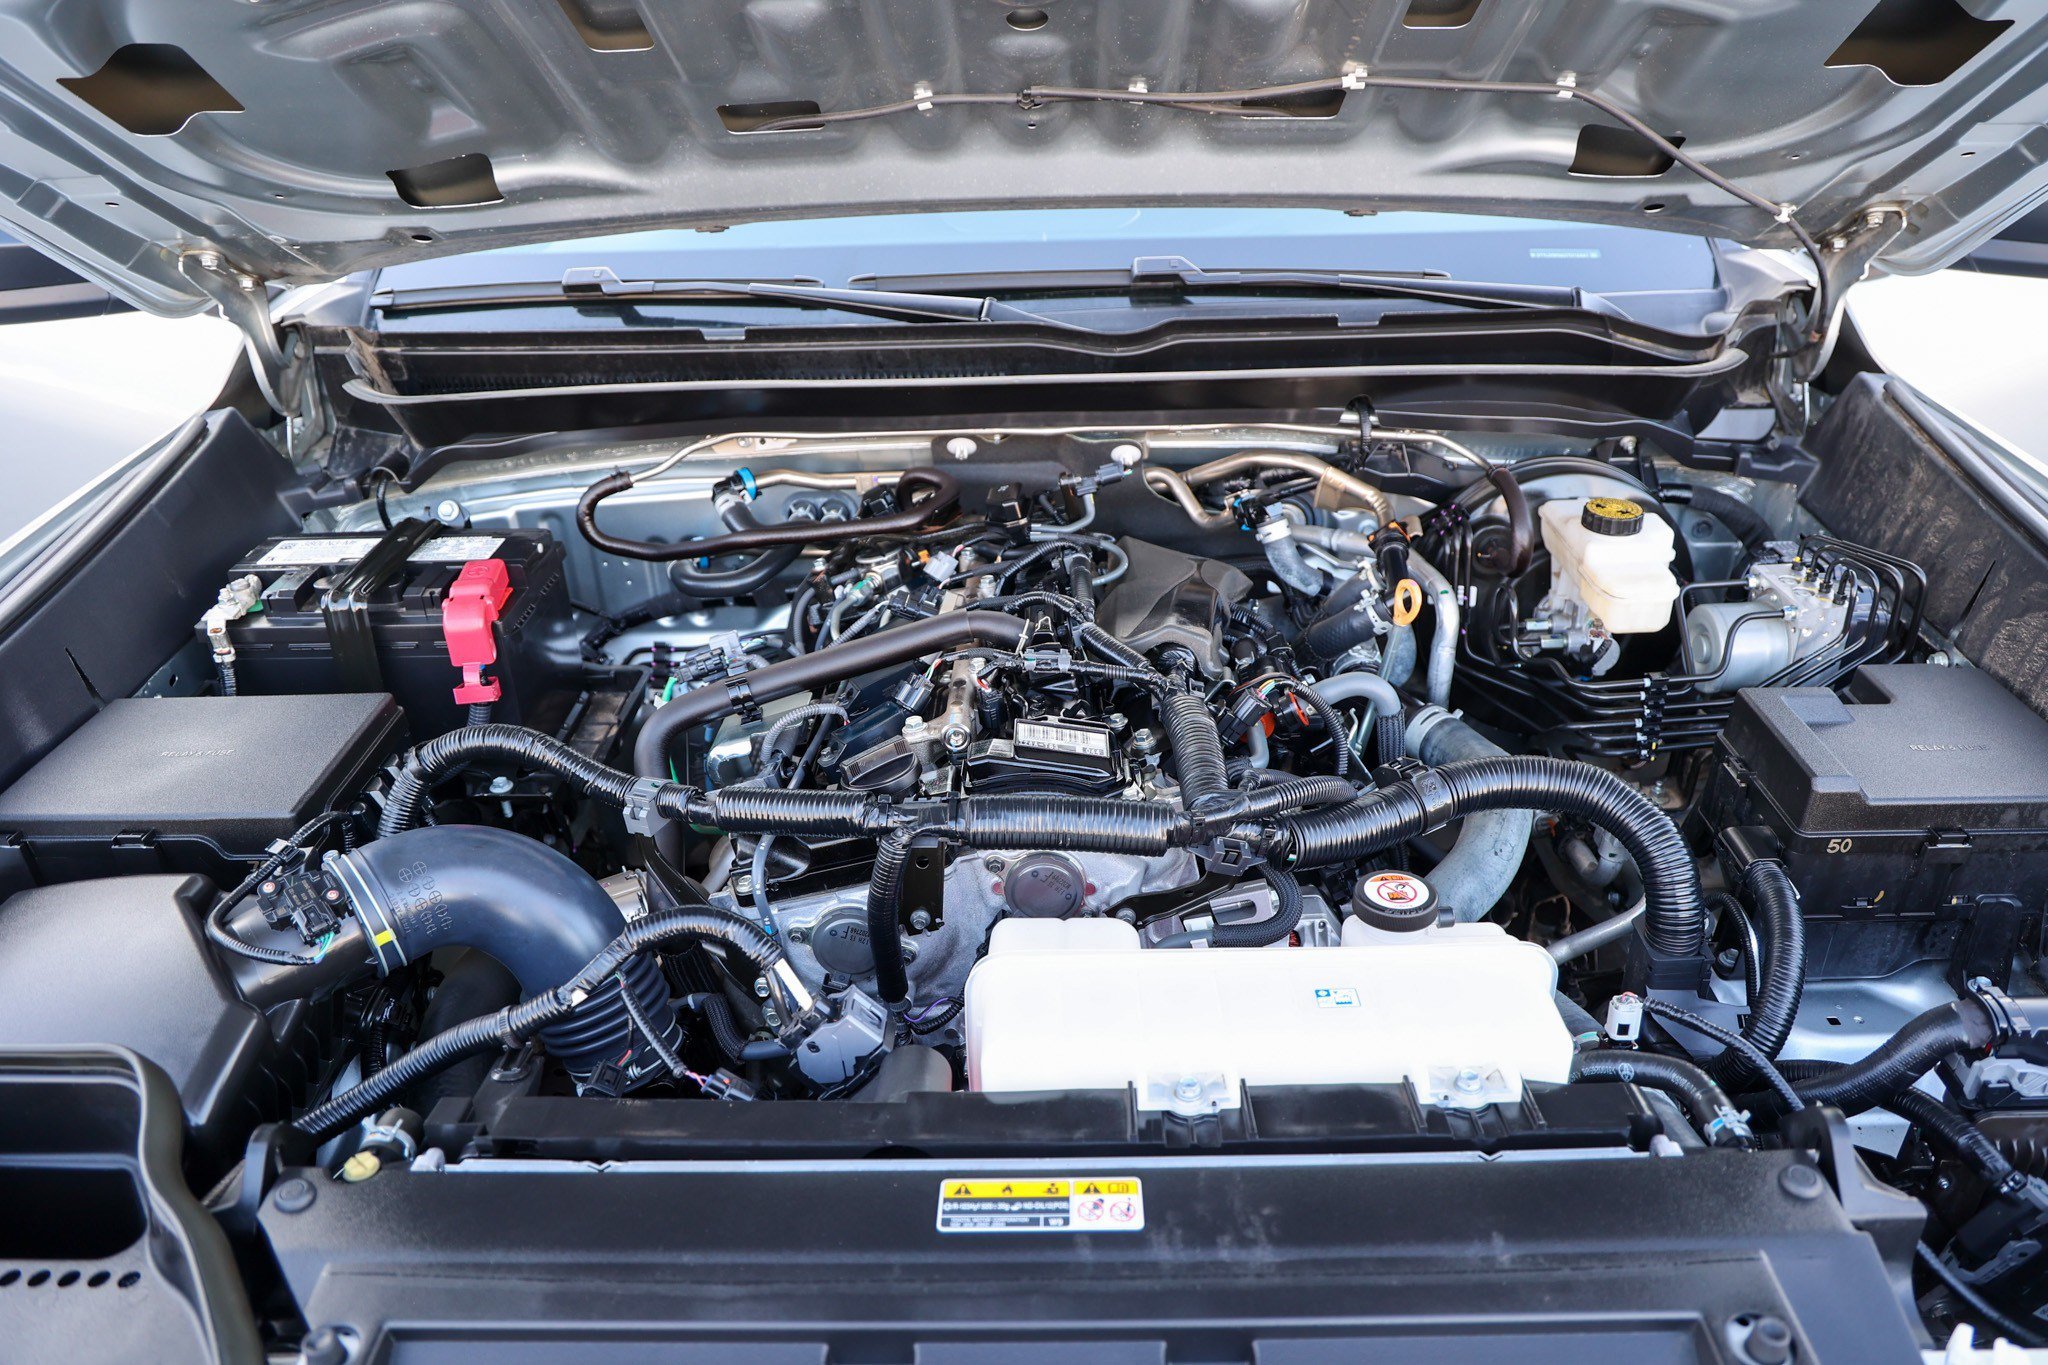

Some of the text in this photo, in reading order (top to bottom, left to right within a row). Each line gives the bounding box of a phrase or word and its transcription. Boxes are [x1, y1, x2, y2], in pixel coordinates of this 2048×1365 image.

[205, 748, 235, 757] FUSE
[1909, 744, 1946, 752] RELAY
[1826, 838, 1853, 854] 50
[840, 925, 851, 940] F
